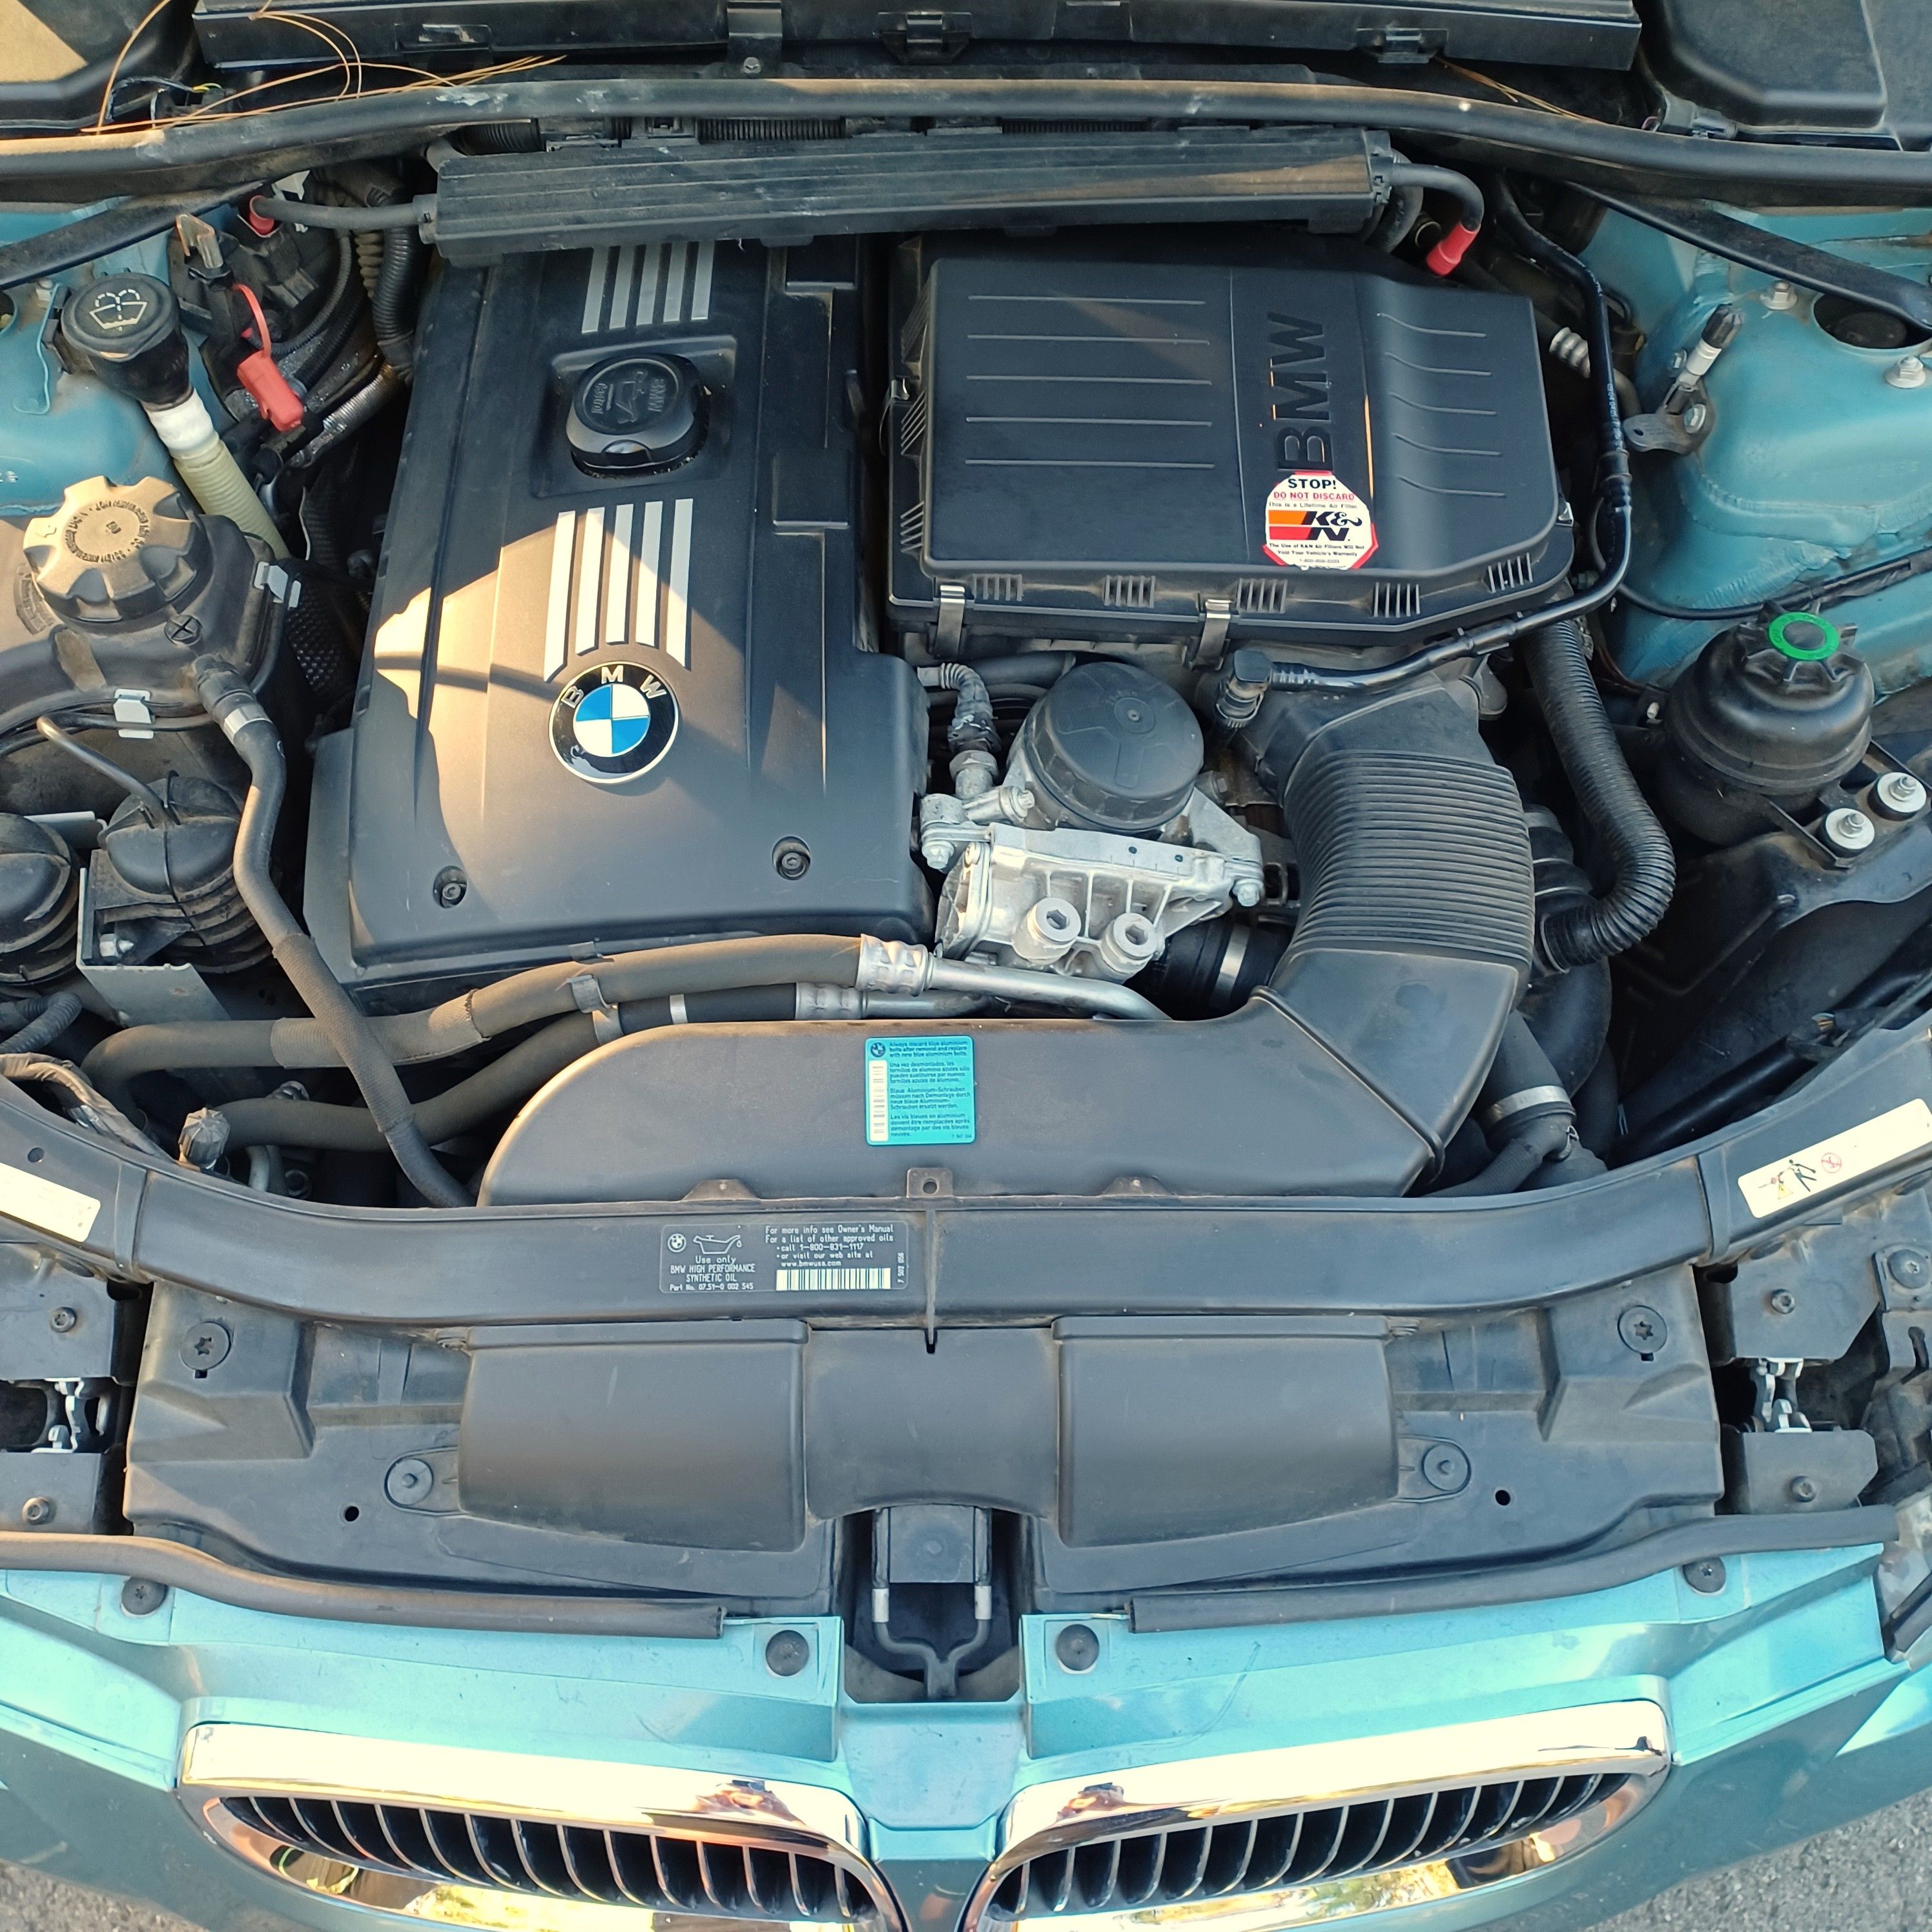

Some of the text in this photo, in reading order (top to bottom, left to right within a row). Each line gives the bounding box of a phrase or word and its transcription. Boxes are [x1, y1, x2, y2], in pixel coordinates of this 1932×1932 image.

[1266, 311, 1334, 471] BMW
[1288, 479, 1337, 489] STOP!
[561, 665, 667, 708] BMW
[766, 1226, 777, 1234] For
[803, 1226, 817, 1234] info
[838, 1225, 865, 1233] Owner's
[868, 1224, 894, 1233] Manual
[766, 1235, 777, 1243] For
[843, 1234, 875, 1242] approved
[695, 1255, 736, 1265] Use only
[671, 1264, 755, 1274] BMW HIGH PERFORMANCE
[686, 1273, 722, 1282] SYNTHETIC
